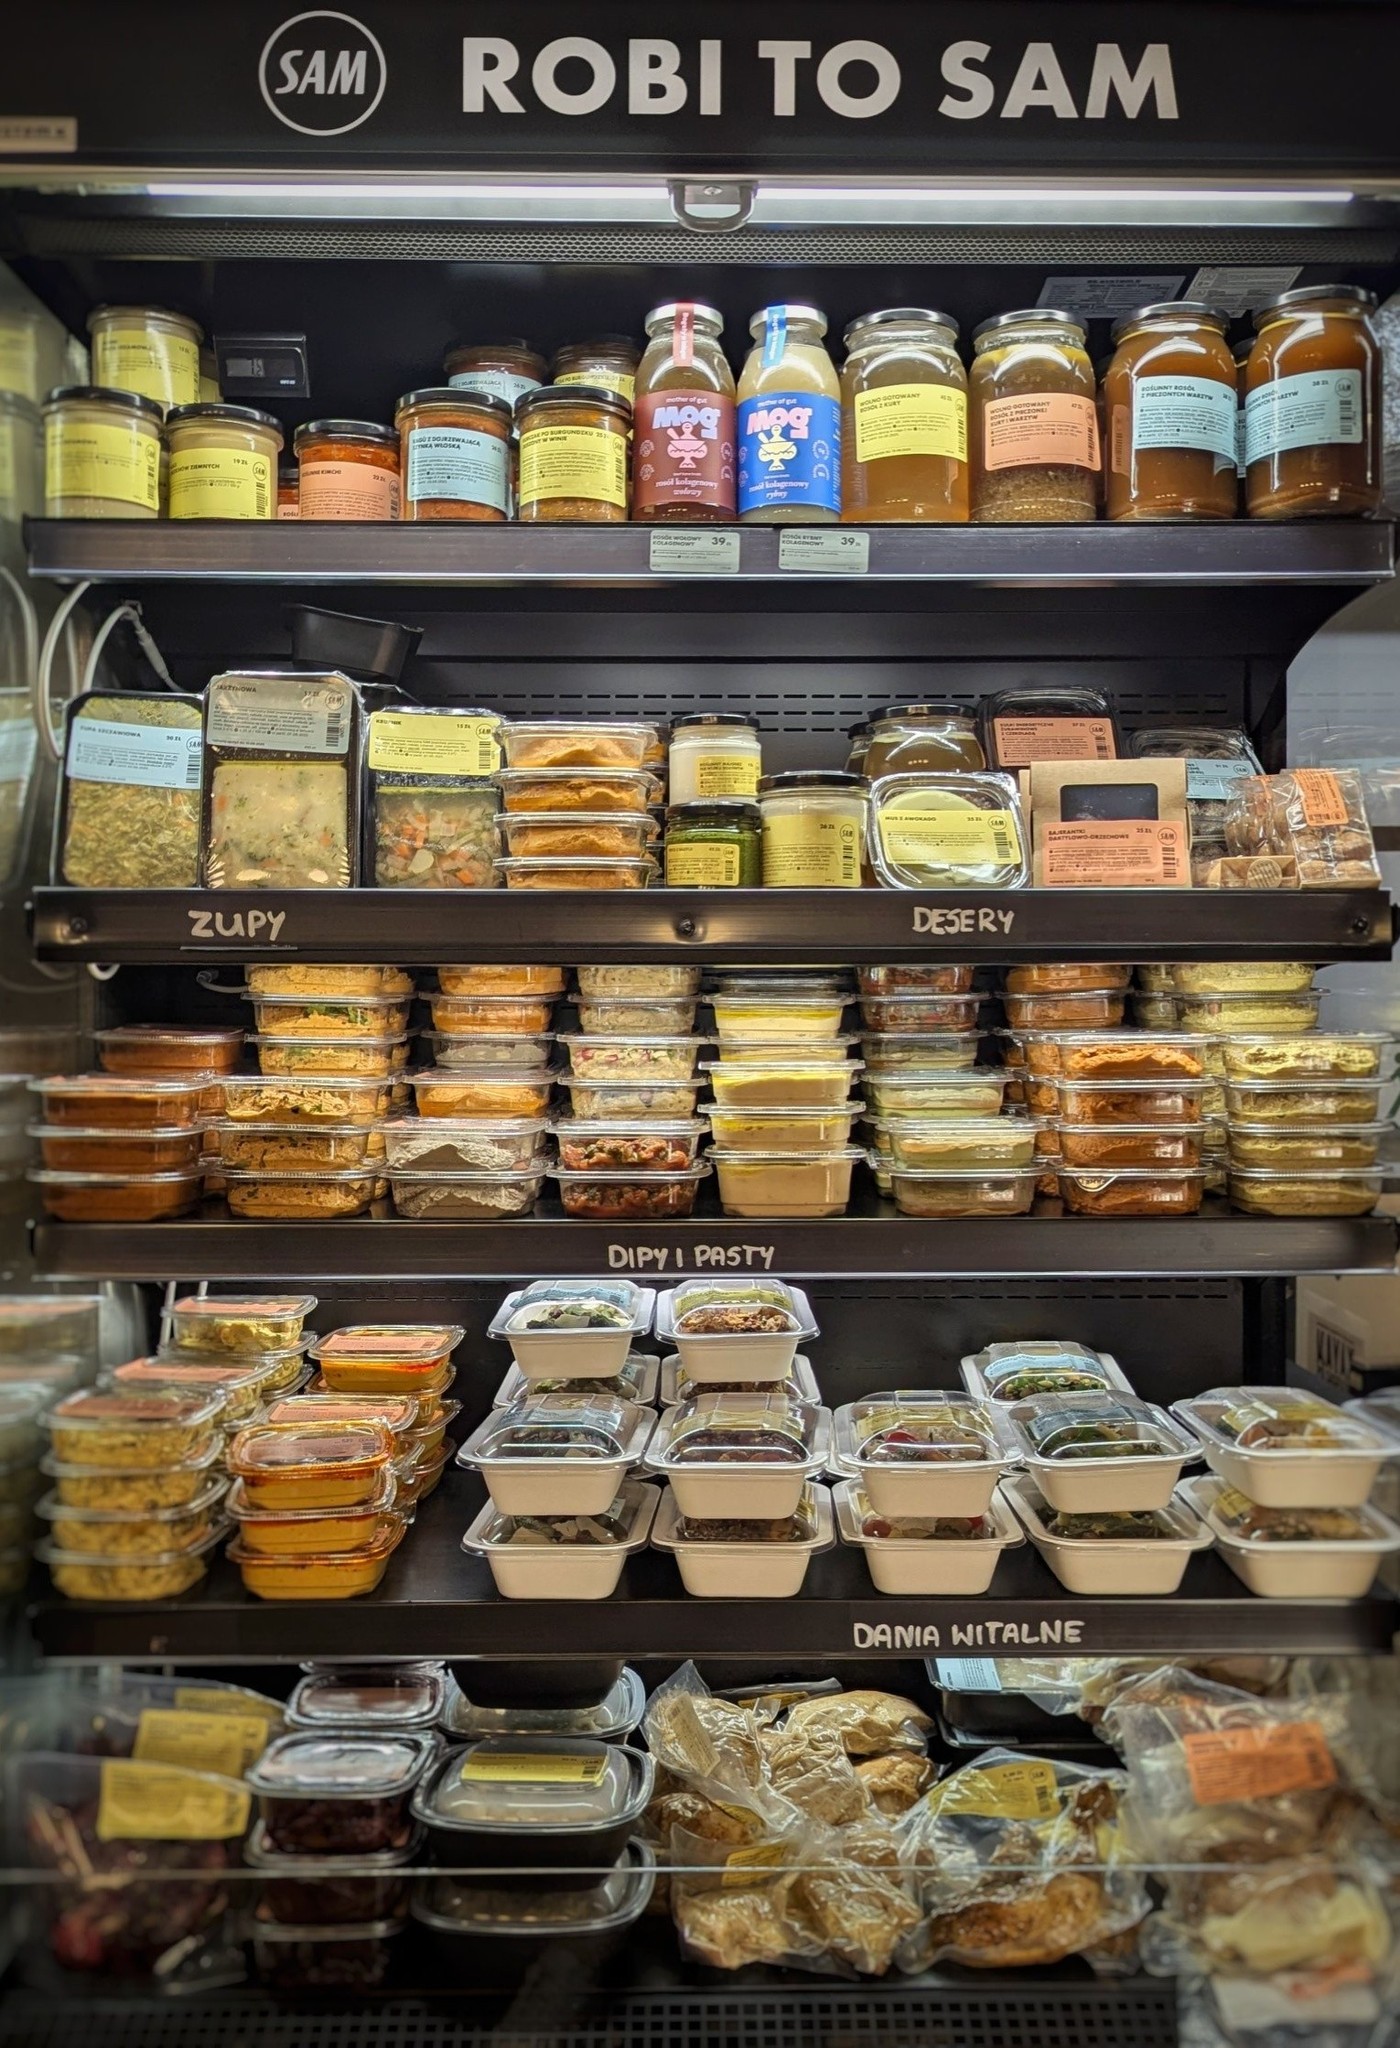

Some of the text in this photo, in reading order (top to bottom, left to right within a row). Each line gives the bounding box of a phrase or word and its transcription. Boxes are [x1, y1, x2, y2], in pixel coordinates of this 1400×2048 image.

[275, 50, 366, 95] SAM
[463, 37, 1179, 119] ROBI TO SAM
[711, 536, 726, 546] 39
[841, 536, 856, 546] 39
[188, 910, 285, 941] ZUPY
[912, 906, 1014, 934] DESERY
[608, 1244, 774, 1270] DIPY I PASTY
[853, 1619, 1085, 1649] DANIA WITALNE
